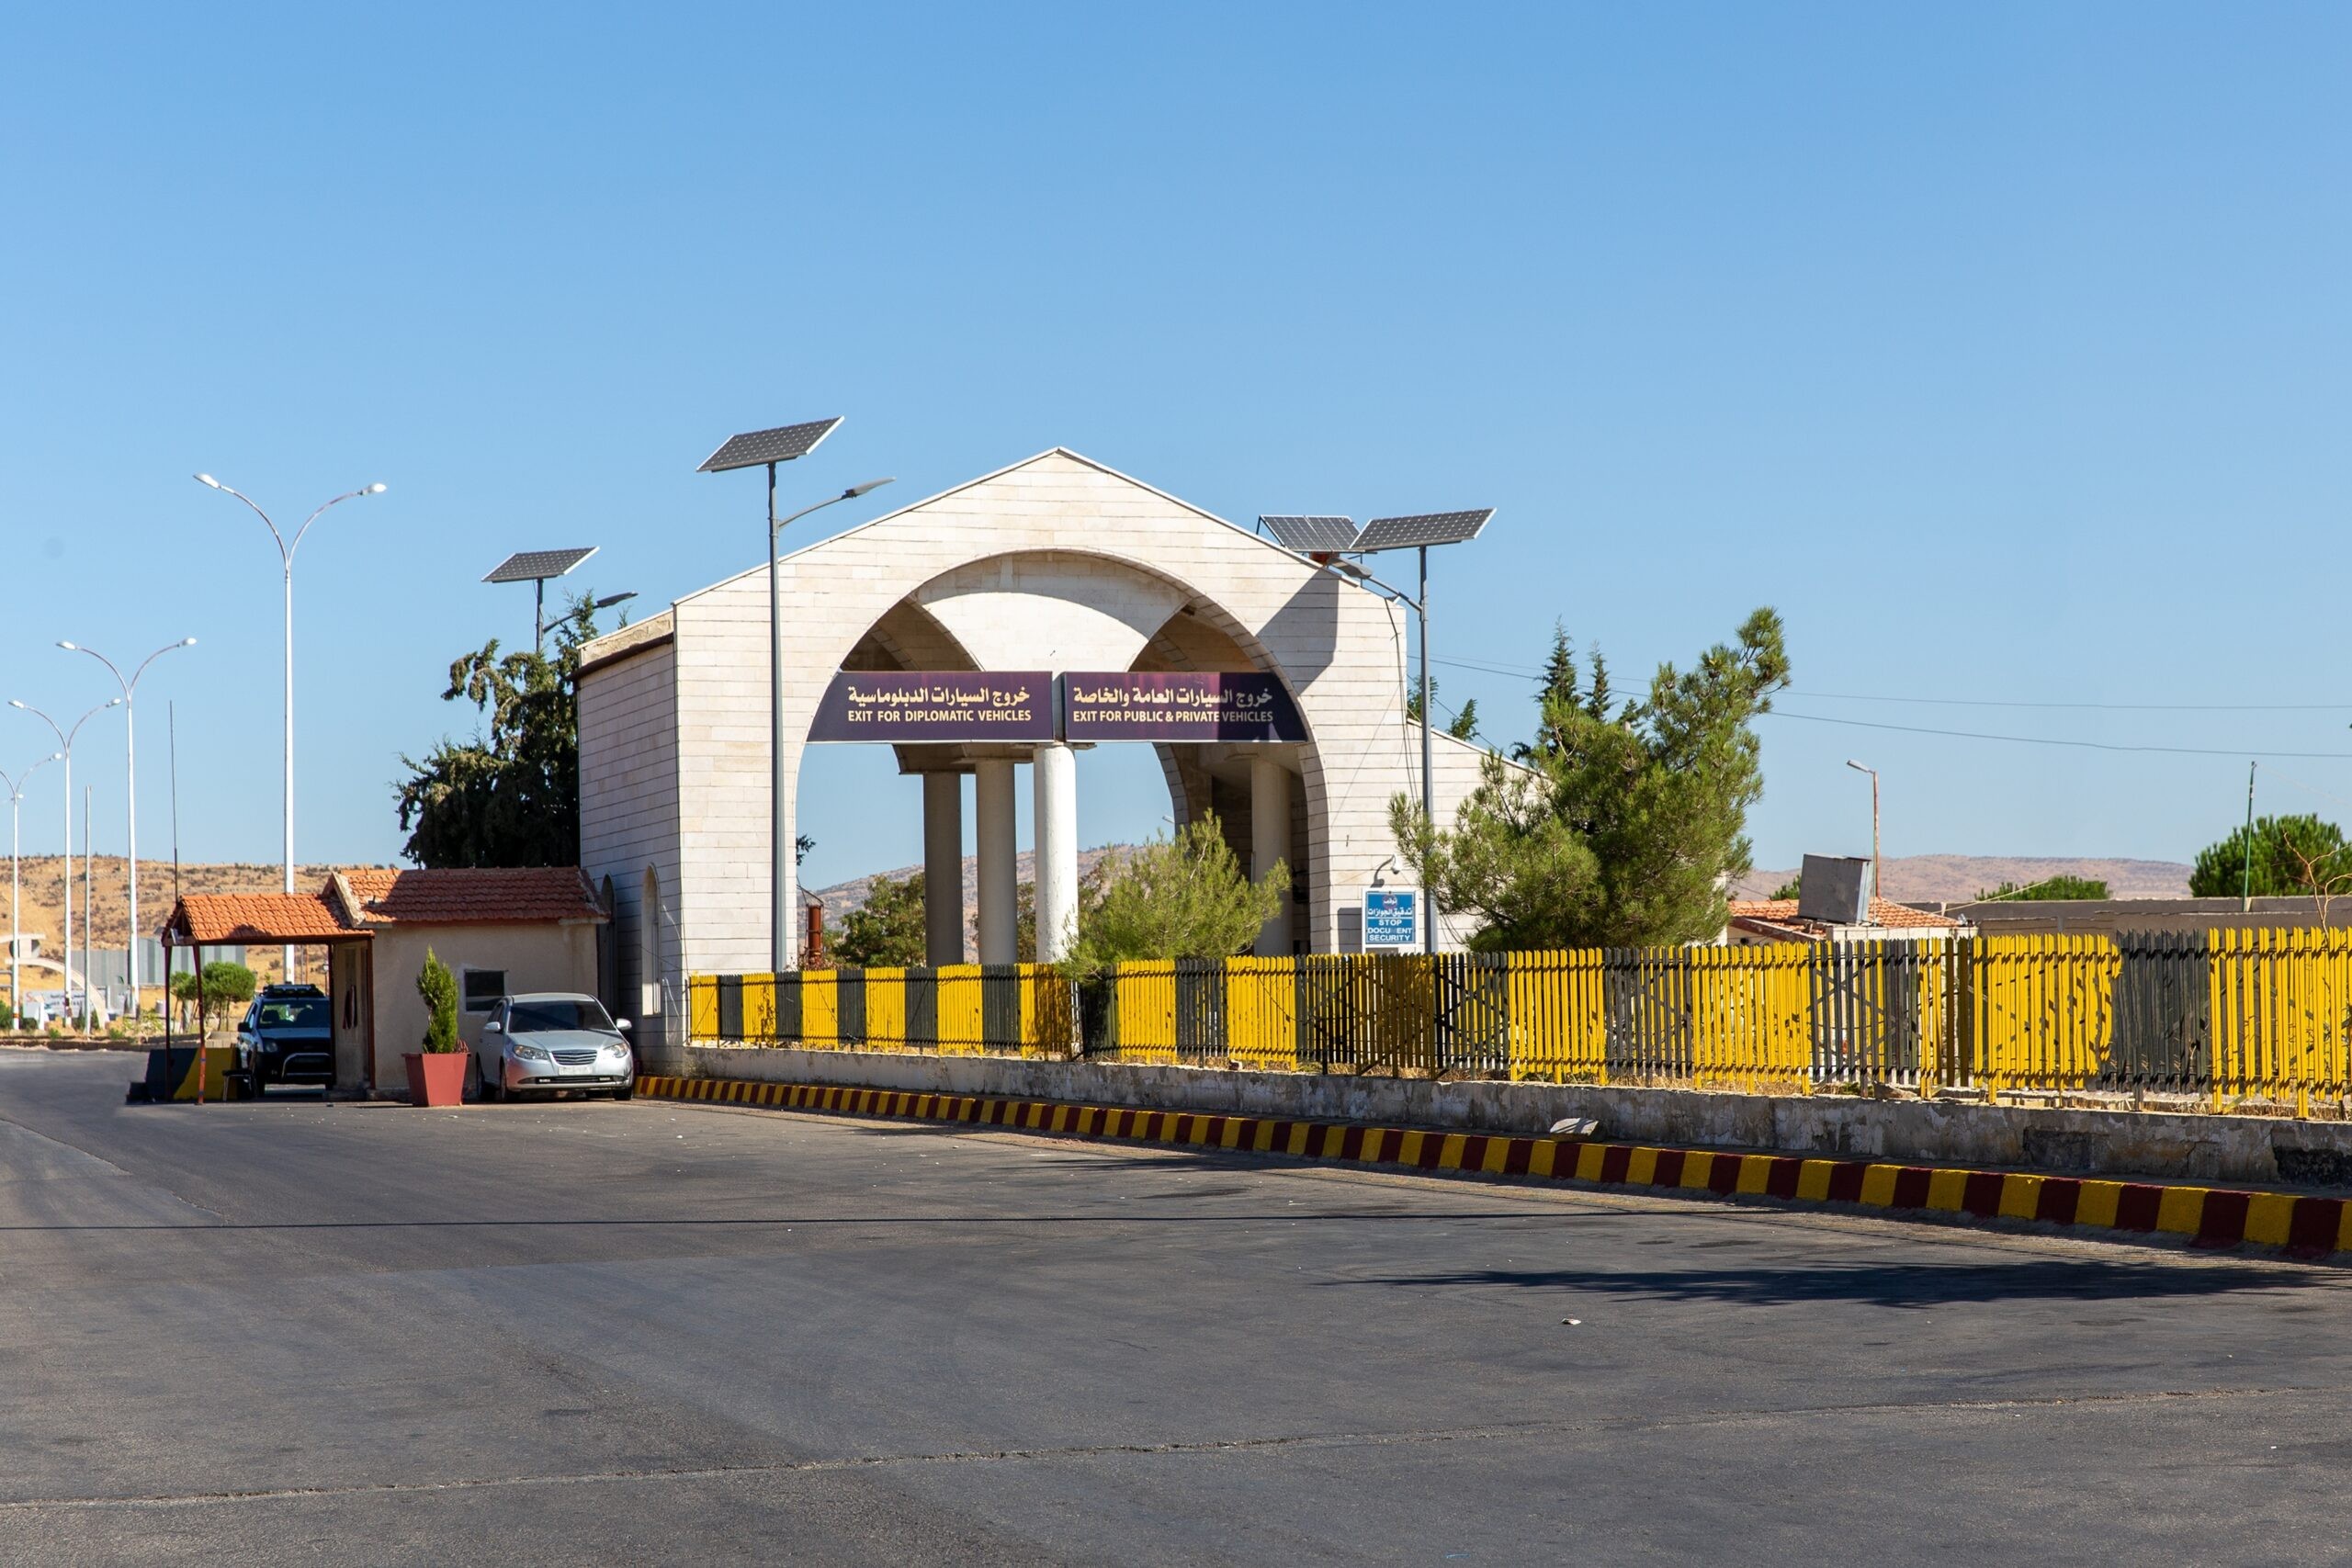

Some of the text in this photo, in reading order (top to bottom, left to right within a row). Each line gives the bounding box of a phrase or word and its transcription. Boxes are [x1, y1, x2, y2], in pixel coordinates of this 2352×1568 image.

[848, 686, 1030, 707] خروج السيارات الدبلوماسية
[1073, 687, 1272, 708] خروج السيارات العامة والخاصة
[848, 709, 1032, 722] EXIT FOR DIPLOMATIC VEHICLES
[1073, 711, 1273, 722] EXIT FOR PUBLIC & PRIVATE VEHICLES
